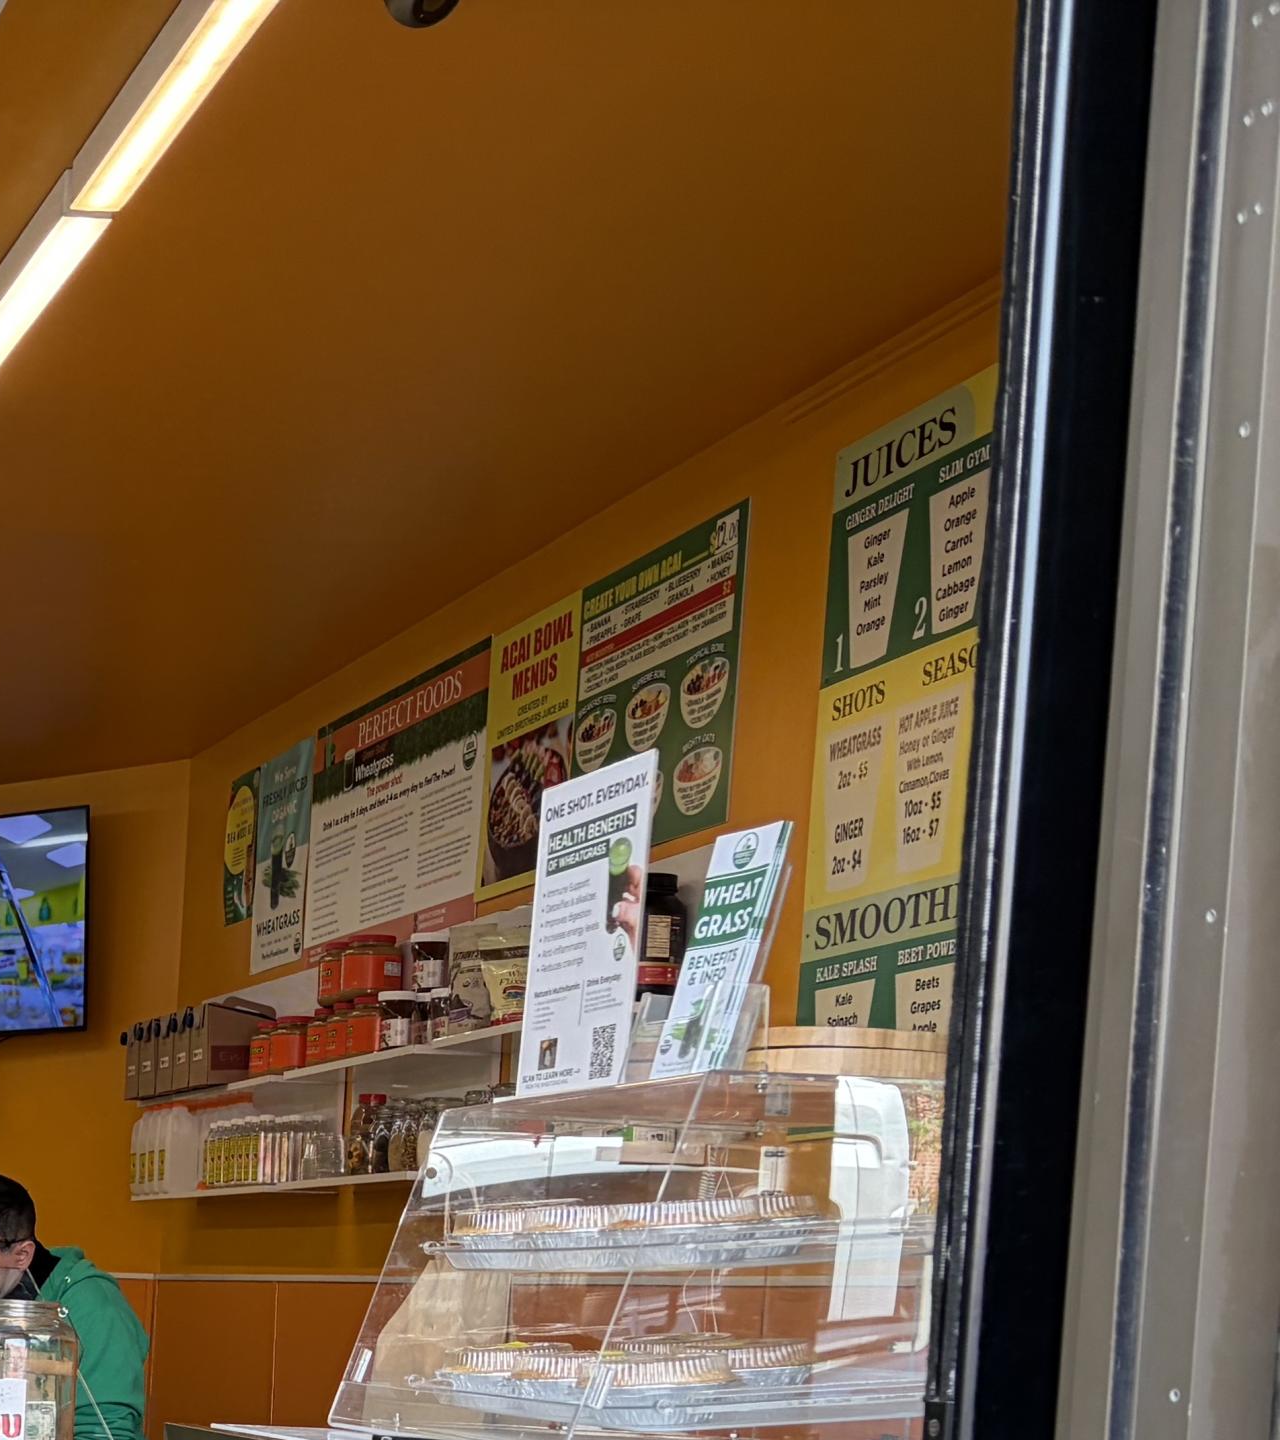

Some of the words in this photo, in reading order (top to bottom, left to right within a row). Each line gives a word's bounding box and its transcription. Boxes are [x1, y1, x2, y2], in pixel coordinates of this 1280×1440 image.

[845, 406, 956, 498] JUICES
[939, 458, 964, 483] SLIM
[845, 498, 877, 530] GINGER
[878, 483, 915, 517] DELIGHT
[948, 485, 976, 510] Apple
[944, 507, 977, 532] Orange
[864, 527, 891, 550] Ginger
[944, 530, 973, 554] Carrot
[867, 552, 885, 569] Kale
[942, 554, 973, 578] Lemon
[590, 616, 611, 632] BANANA
[624, 589, 660, 615] STRAWBERRY
[667, 569, 701, 592] BLUEBERRY
[710, 551, 734, 569] MANGO
[859, 571, 889, 594] Parsley
[936, 575, 975, 602] Cabbage
[589, 624, 618, 644] PINEAPPLE
[623, 612, 642, 628] GRAPE
[667, 585, 694, 605] GRANOLA
[709, 567, 730, 582] HONEY
[863, 594, 881, 613] Mint
[938, 600, 968, 623] Ginger
[856, 614, 886, 636] Orange
[912, 596, 927, 640] 2
[501, 633, 531, 674] ACAI
[534, 611, 574, 656] BOWL
[834, 633, 844, 673] 1
[512, 653, 558, 700] MENUS
[358, 696, 413, 748] PERFECT
[416, 670, 463, 718] FOODS
[832, 680, 886, 721] SHOTS
[899, 712, 913, 735] HOT
[914, 703, 937, 728] APPLE
[938, 696, 959, 721] JUICE
[829, 725, 882, 762] WHEATGRASS
[899, 739, 920, 757] Honey
[922, 734, 930, 748] or
[931, 724, 956, 746] Ginger
[355, 753, 394, 782] Wheatgrass
[906, 759, 921, 772] With
[837, 769, 852, 790] 2oz
[546, 803, 565, 822] ONE
[567, 793, 594, 817] SHOT.
[596, 771, 649, 804] EVERYDAY.
[904, 798, 923, 819] 10oz
[931, 791, 941, 812] $5
[548, 826, 586, 853] HEALTH
[587, 809, 636, 841] BENEFITS
[835, 817, 863, 844] GINGER
[903, 826, 921, 845] 16oz
[929, 818, 939, 837] $7
[548, 859, 558, 872] OF
[559, 843, 607, 868] WHEATGRASS
[832, 856, 846, 876] 2oz
[852, 849, 862, 872] $4
[703, 876, 763, 909] WHEAT
[256, 909, 300, 937] WHEATGRASS
[694, 907, 752, 940] GRASS
[687, 947, 738, 971] BENEFITS
[816, 964, 840, 982] KALE
[842, 956, 877, 978] SPLASH
[898, 948, 923, 965] BEET
[700, 967, 726, 984] INFO
[915, 977, 939, 991] Beets
[835, 993, 852, 1006] Kale
[910, 999, 941, 1014] Grapes
[827, 1013, 858, 1027] Spinach
